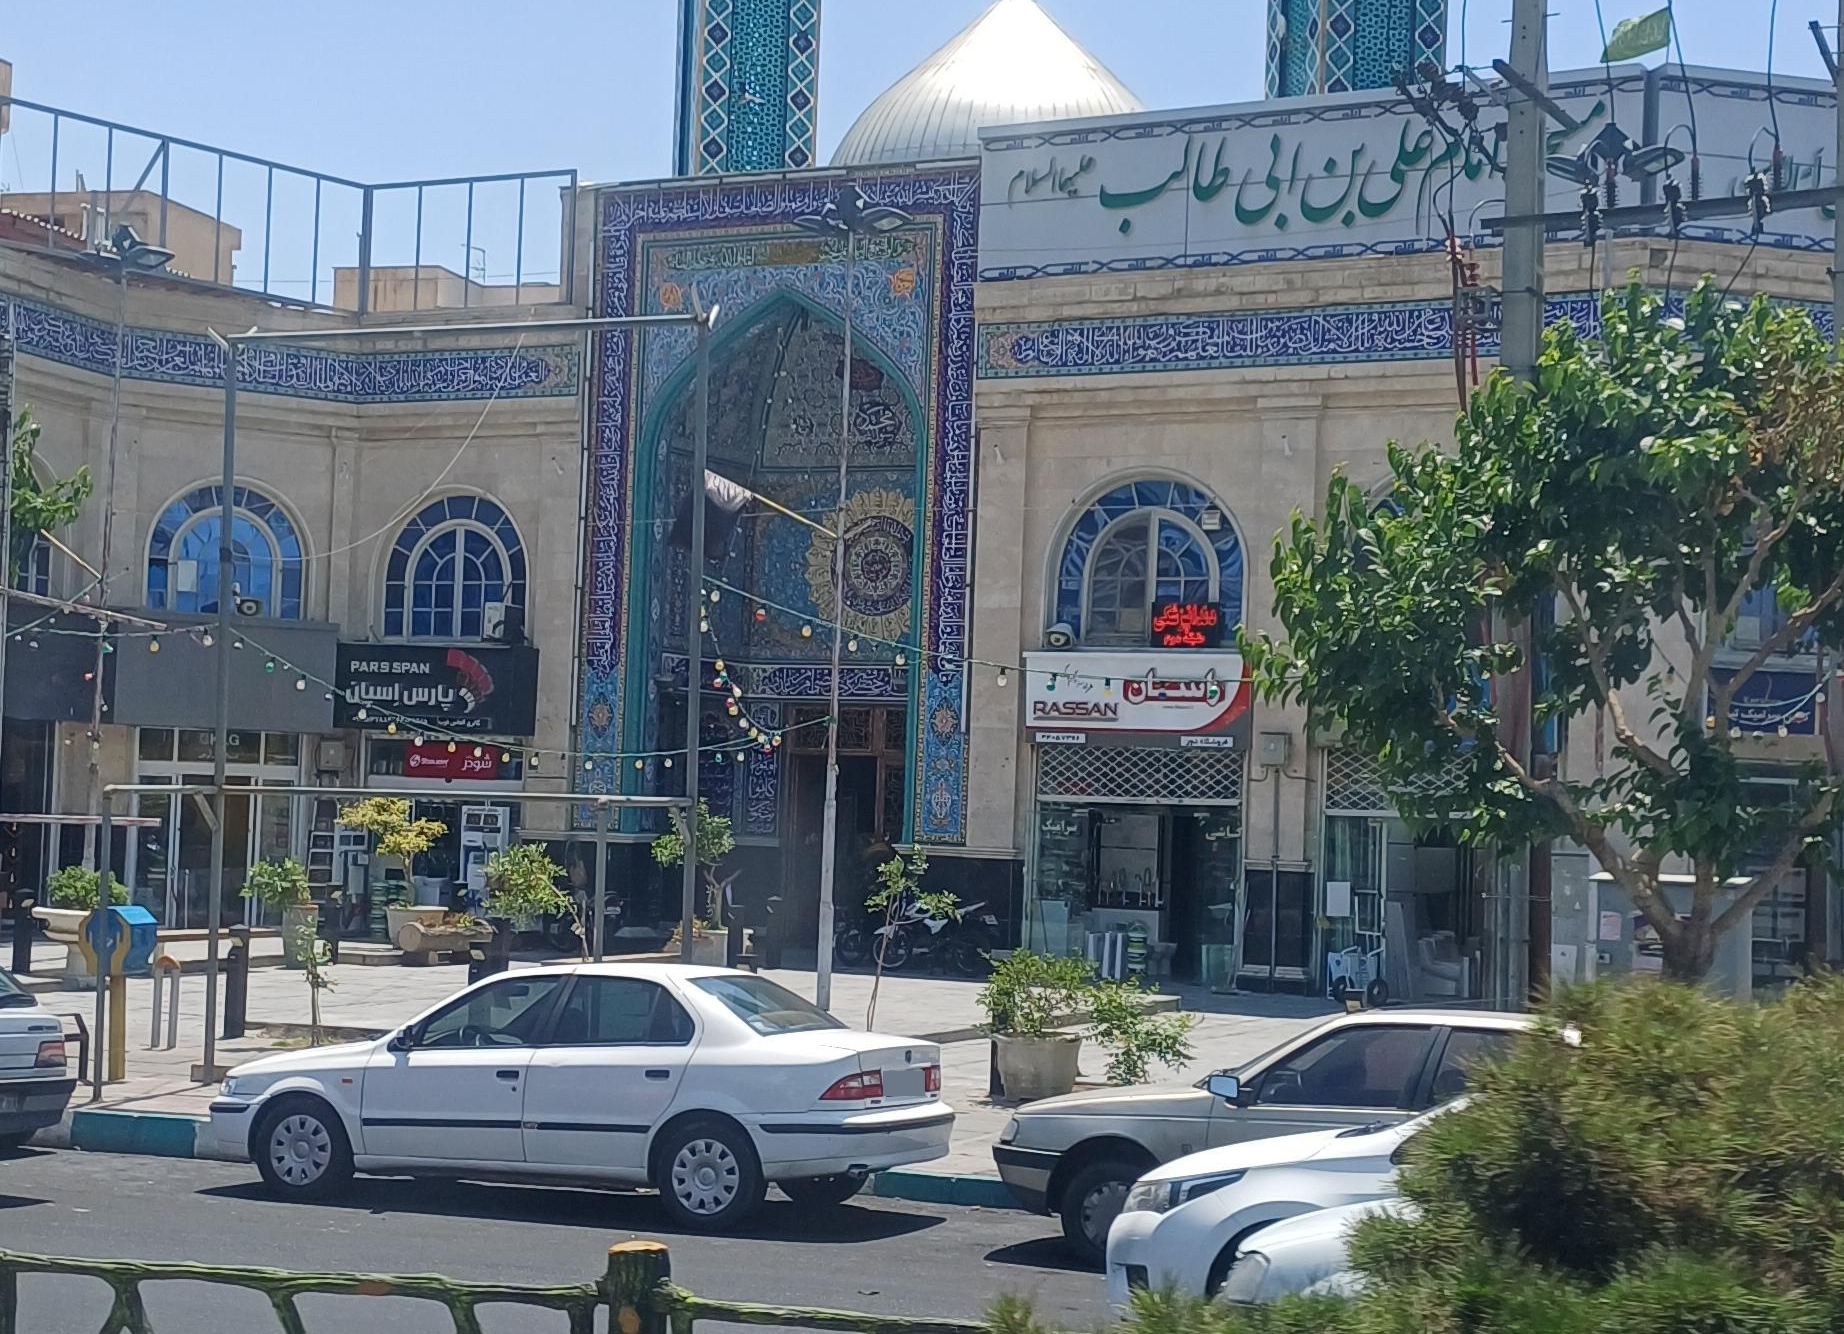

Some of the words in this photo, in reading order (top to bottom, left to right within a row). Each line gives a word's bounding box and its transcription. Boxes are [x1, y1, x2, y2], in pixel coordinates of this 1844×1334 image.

[1099, 133, 1231, 235] طالب
[1300, 142, 1365, 228] بن
[350, 660, 390, 674] PARS
[391, 662, 431, 675] SPAN
[403, 684, 454, 712] پارس
[1032, 700, 1119, 717] RASSAN
